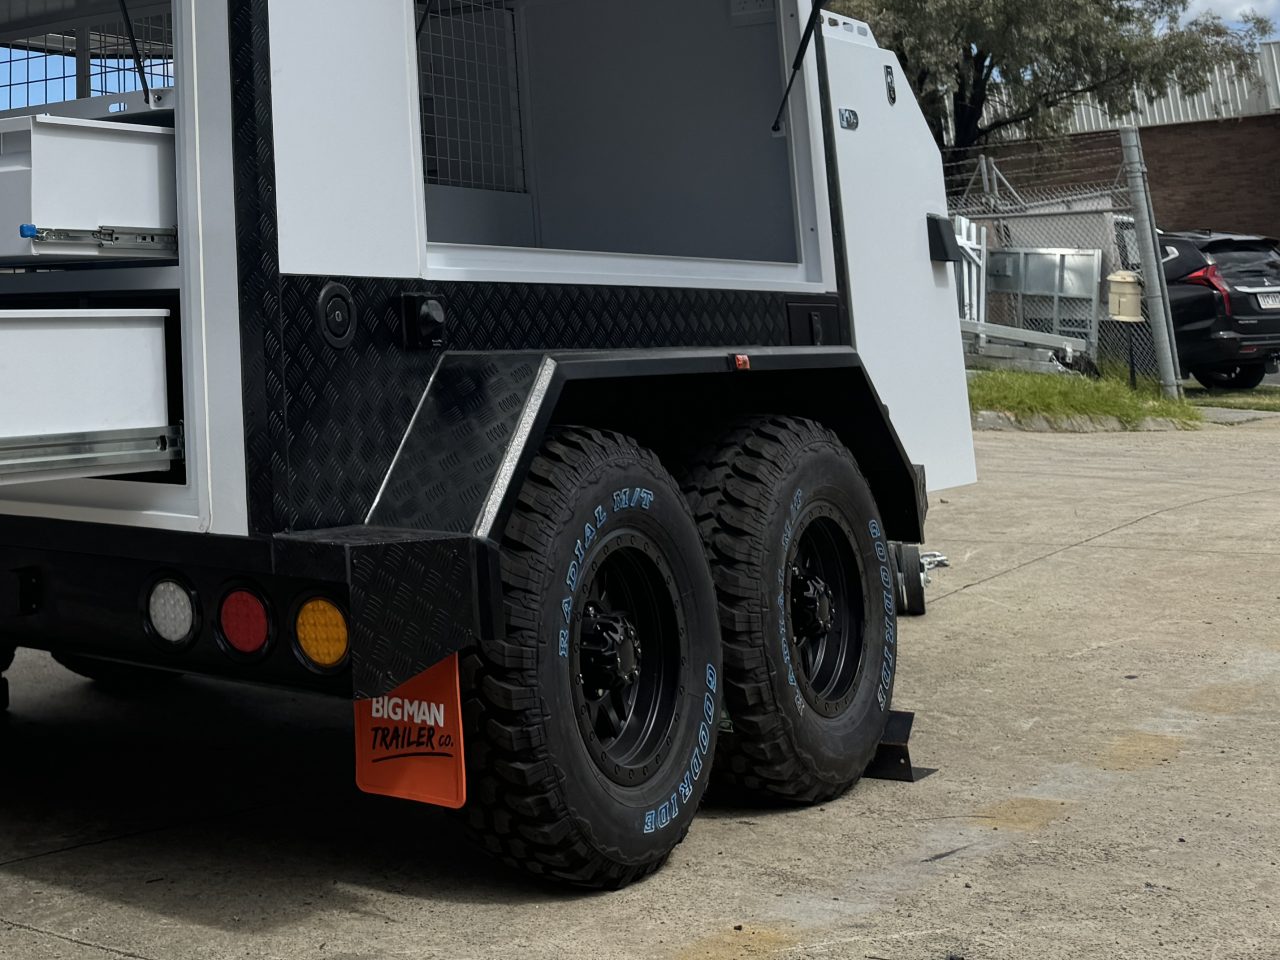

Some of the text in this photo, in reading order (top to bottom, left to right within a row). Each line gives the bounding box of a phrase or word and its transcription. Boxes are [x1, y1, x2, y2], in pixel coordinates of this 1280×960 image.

[558, 487, 654, 658] RADIAL M/T
[868, 519, 894, 712] GOODRIDE
[371, 696, 445, 728] BIGMAN
[371, 726, 436, 751] TRAILER
[643, 663, 717, 834] GOODRIDE
